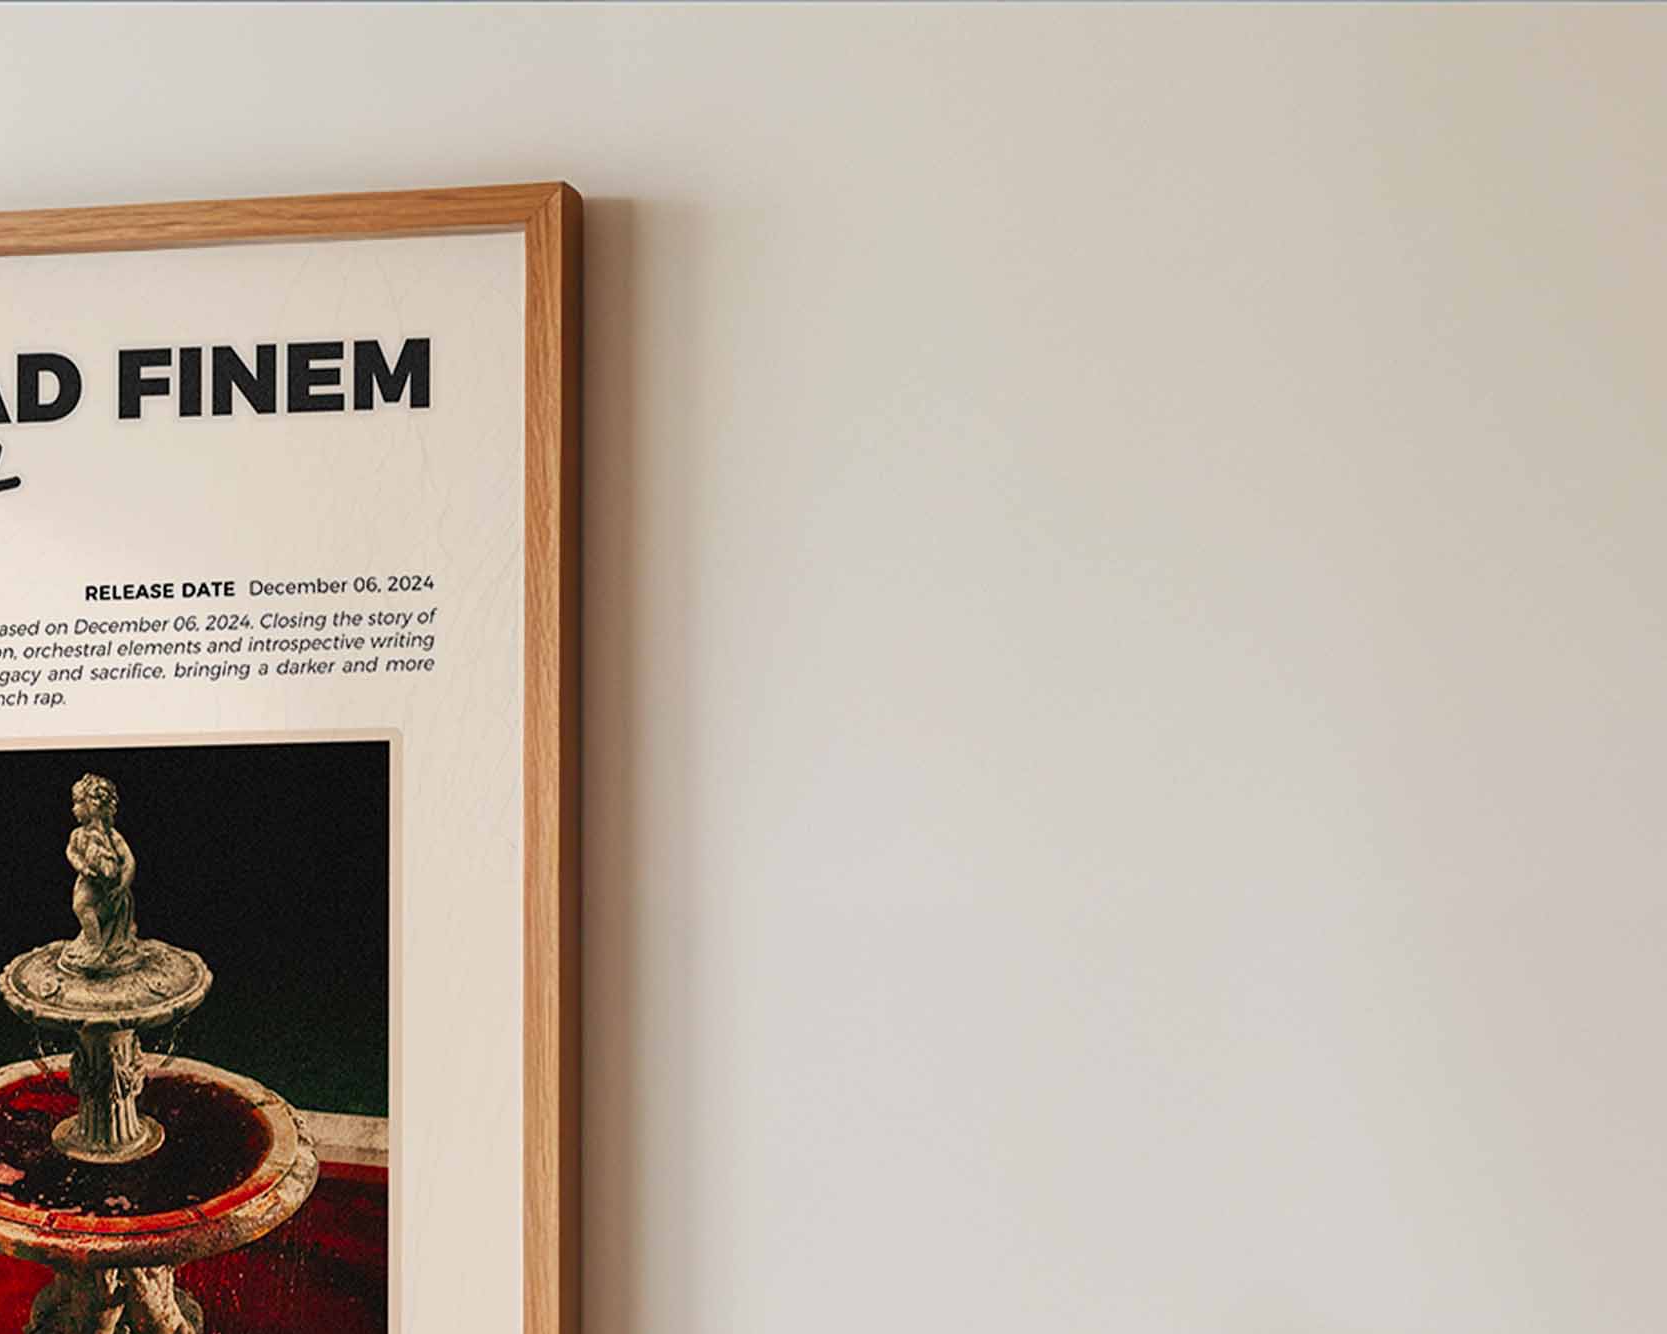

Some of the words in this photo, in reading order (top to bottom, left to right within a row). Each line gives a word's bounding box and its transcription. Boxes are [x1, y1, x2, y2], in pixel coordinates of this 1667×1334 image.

[118, 337, 431, 419] FINEM
[84, 582, 175, 602] RELEASE
[181, 580, 236, 599] DATE
[248, 577, 348, 597] December
[387, 574, 435, 593] 2024
[44, 622, 69, 637] on
[73, 616, 170, 636] December
[204, 613, 254, 632] 2024.
[259, 611, 327, 632] Closing
[332, 610, 364, 628] the
[367, 610, 414, 630] story
[416, 607, 438, 625] of
[22, 640, 113, 660] orchestral
[116, 639, 202, 657] elements
[206, 636, 244, 655] and
[247, 633, 366, 655] introspective
[369, 631, 435, 652] writing
[47, 664, 85, 683] and
[173, 660, 251, 682] bringing
[257, 662, 269, 677] a
[275, 657, 336, 676] darker
[341, 655, 380, 674] and
[385, 657, 436, 673] more
[33, 691, 67, 709] rap.
